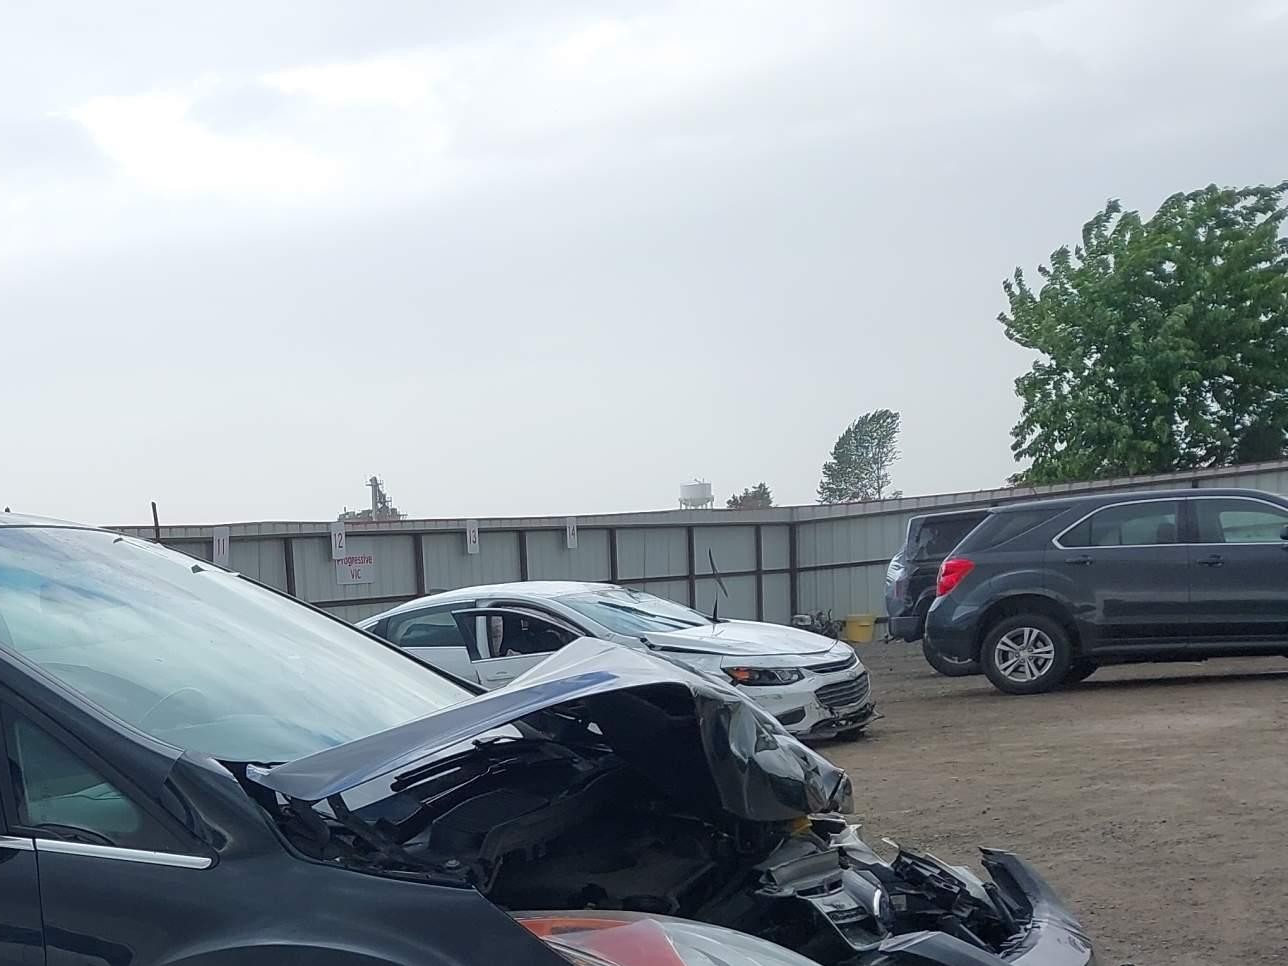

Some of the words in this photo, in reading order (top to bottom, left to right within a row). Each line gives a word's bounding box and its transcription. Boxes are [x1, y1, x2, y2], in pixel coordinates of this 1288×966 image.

[334, 533, 343, 549] 12
[469, 528, 477, 544] 13
[217, 538, 225, 555] 11
